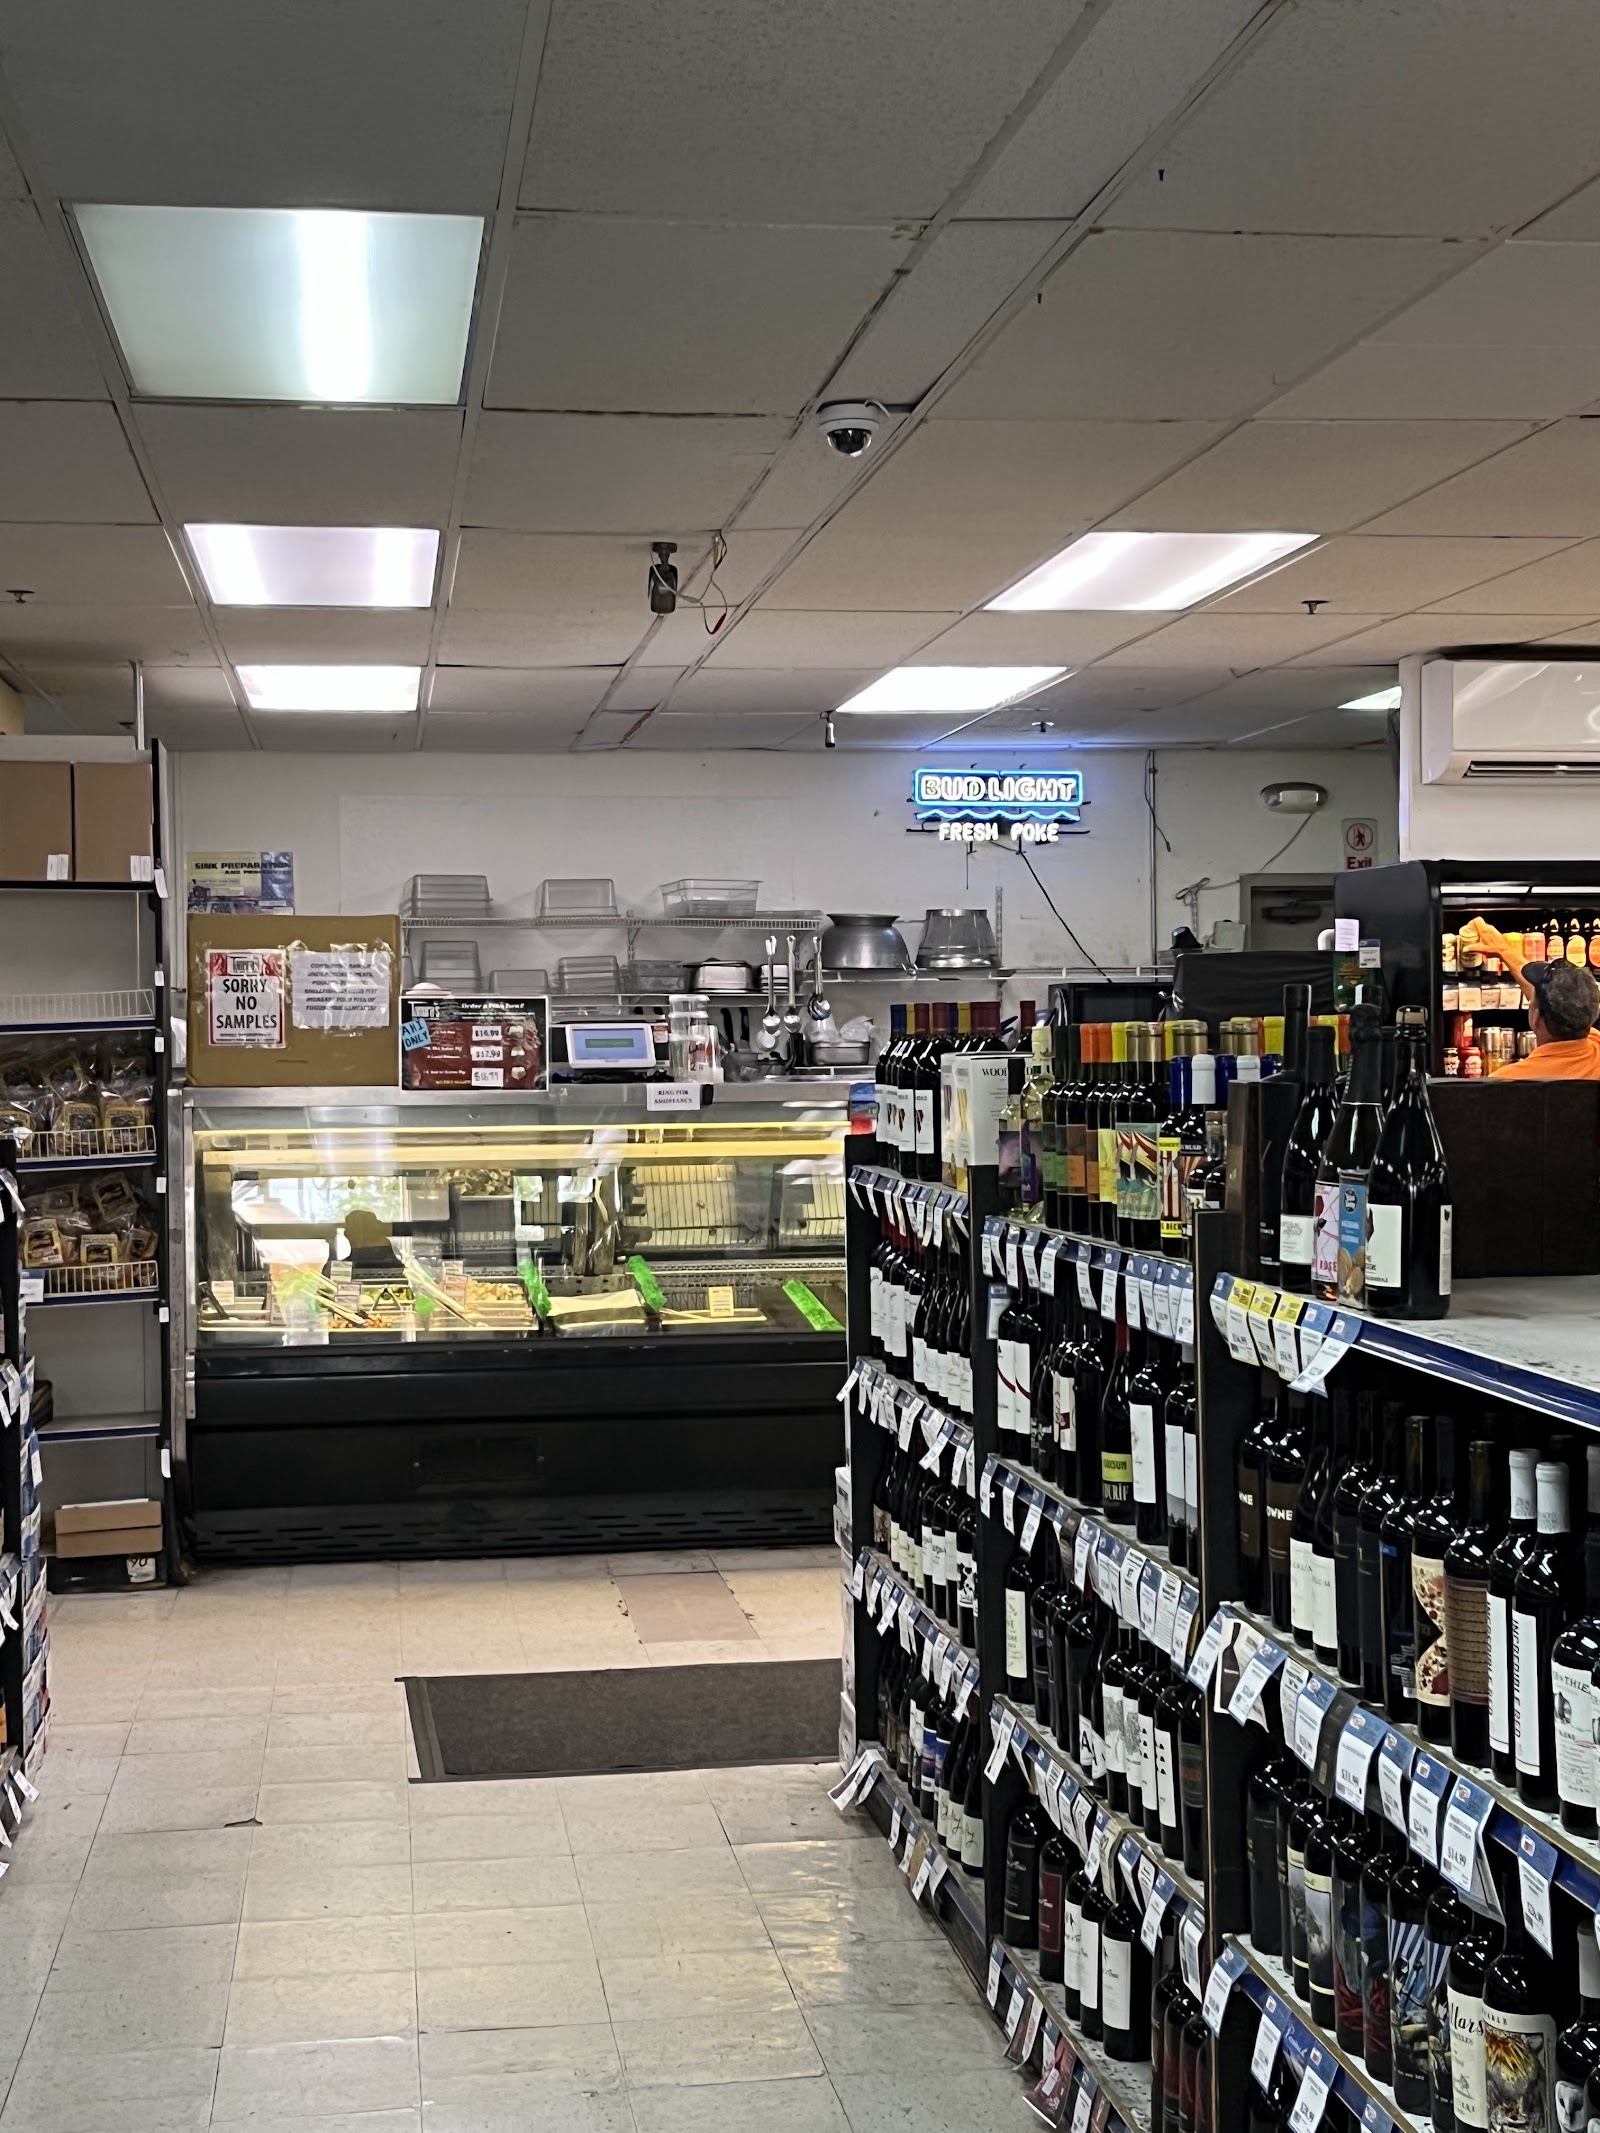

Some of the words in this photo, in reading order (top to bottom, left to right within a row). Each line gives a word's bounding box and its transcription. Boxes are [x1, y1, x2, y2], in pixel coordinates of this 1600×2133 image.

[920, 775, 986, 801] BUD
[987, 777, 1076, 802] LIGHT
[938, 822, 999, 842] FRESH
[1010, 822, 1059, 842] POKE
[194, 862, 218, 870] SINK
[1346, 856, 1372, 870] Exit
[223, 978, 268, 993] SORRY
[235, 995, 257, 1010] NO
[216, 1014, 277, 1029] SAMPLES
[405, 1033, 429, 1048] ONLY
